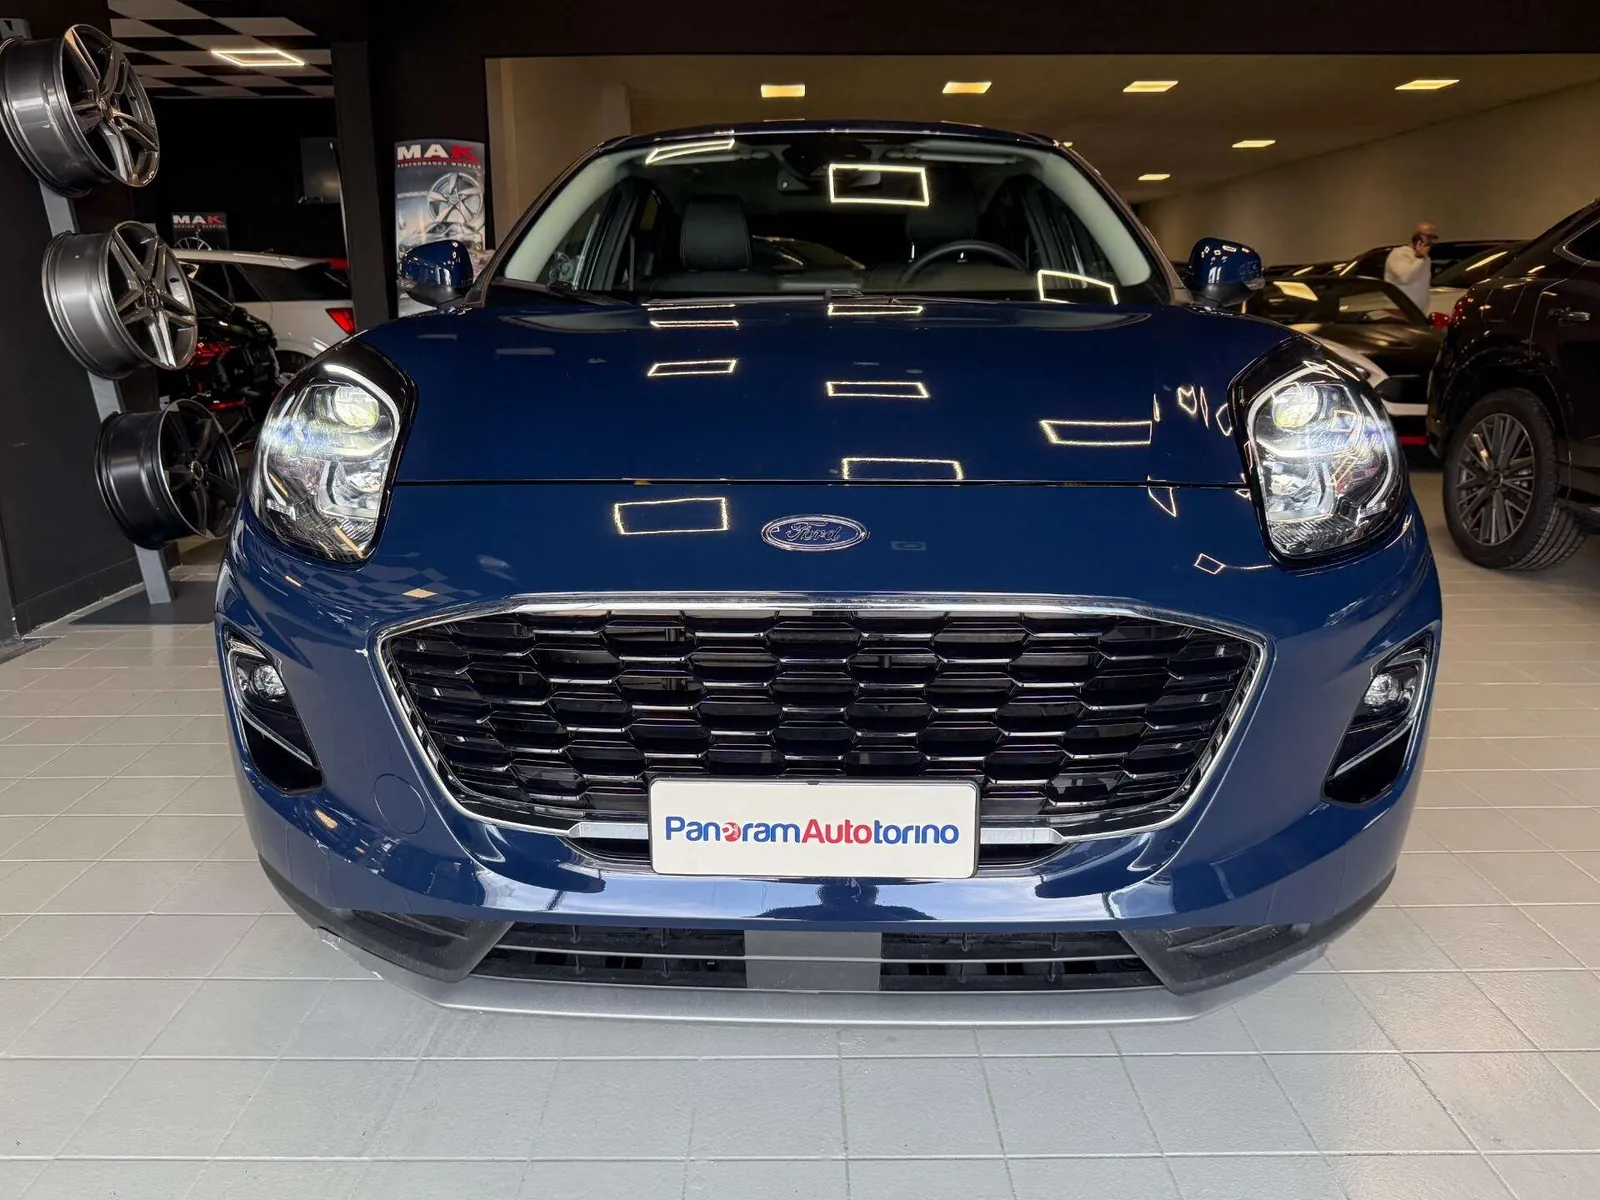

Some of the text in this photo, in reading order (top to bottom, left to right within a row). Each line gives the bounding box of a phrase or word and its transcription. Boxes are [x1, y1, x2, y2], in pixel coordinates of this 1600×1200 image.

[397, 144, 479, 164] MAK
[173, 215, 224, 225] MAK
[786, 521, 842, 541] Ford
